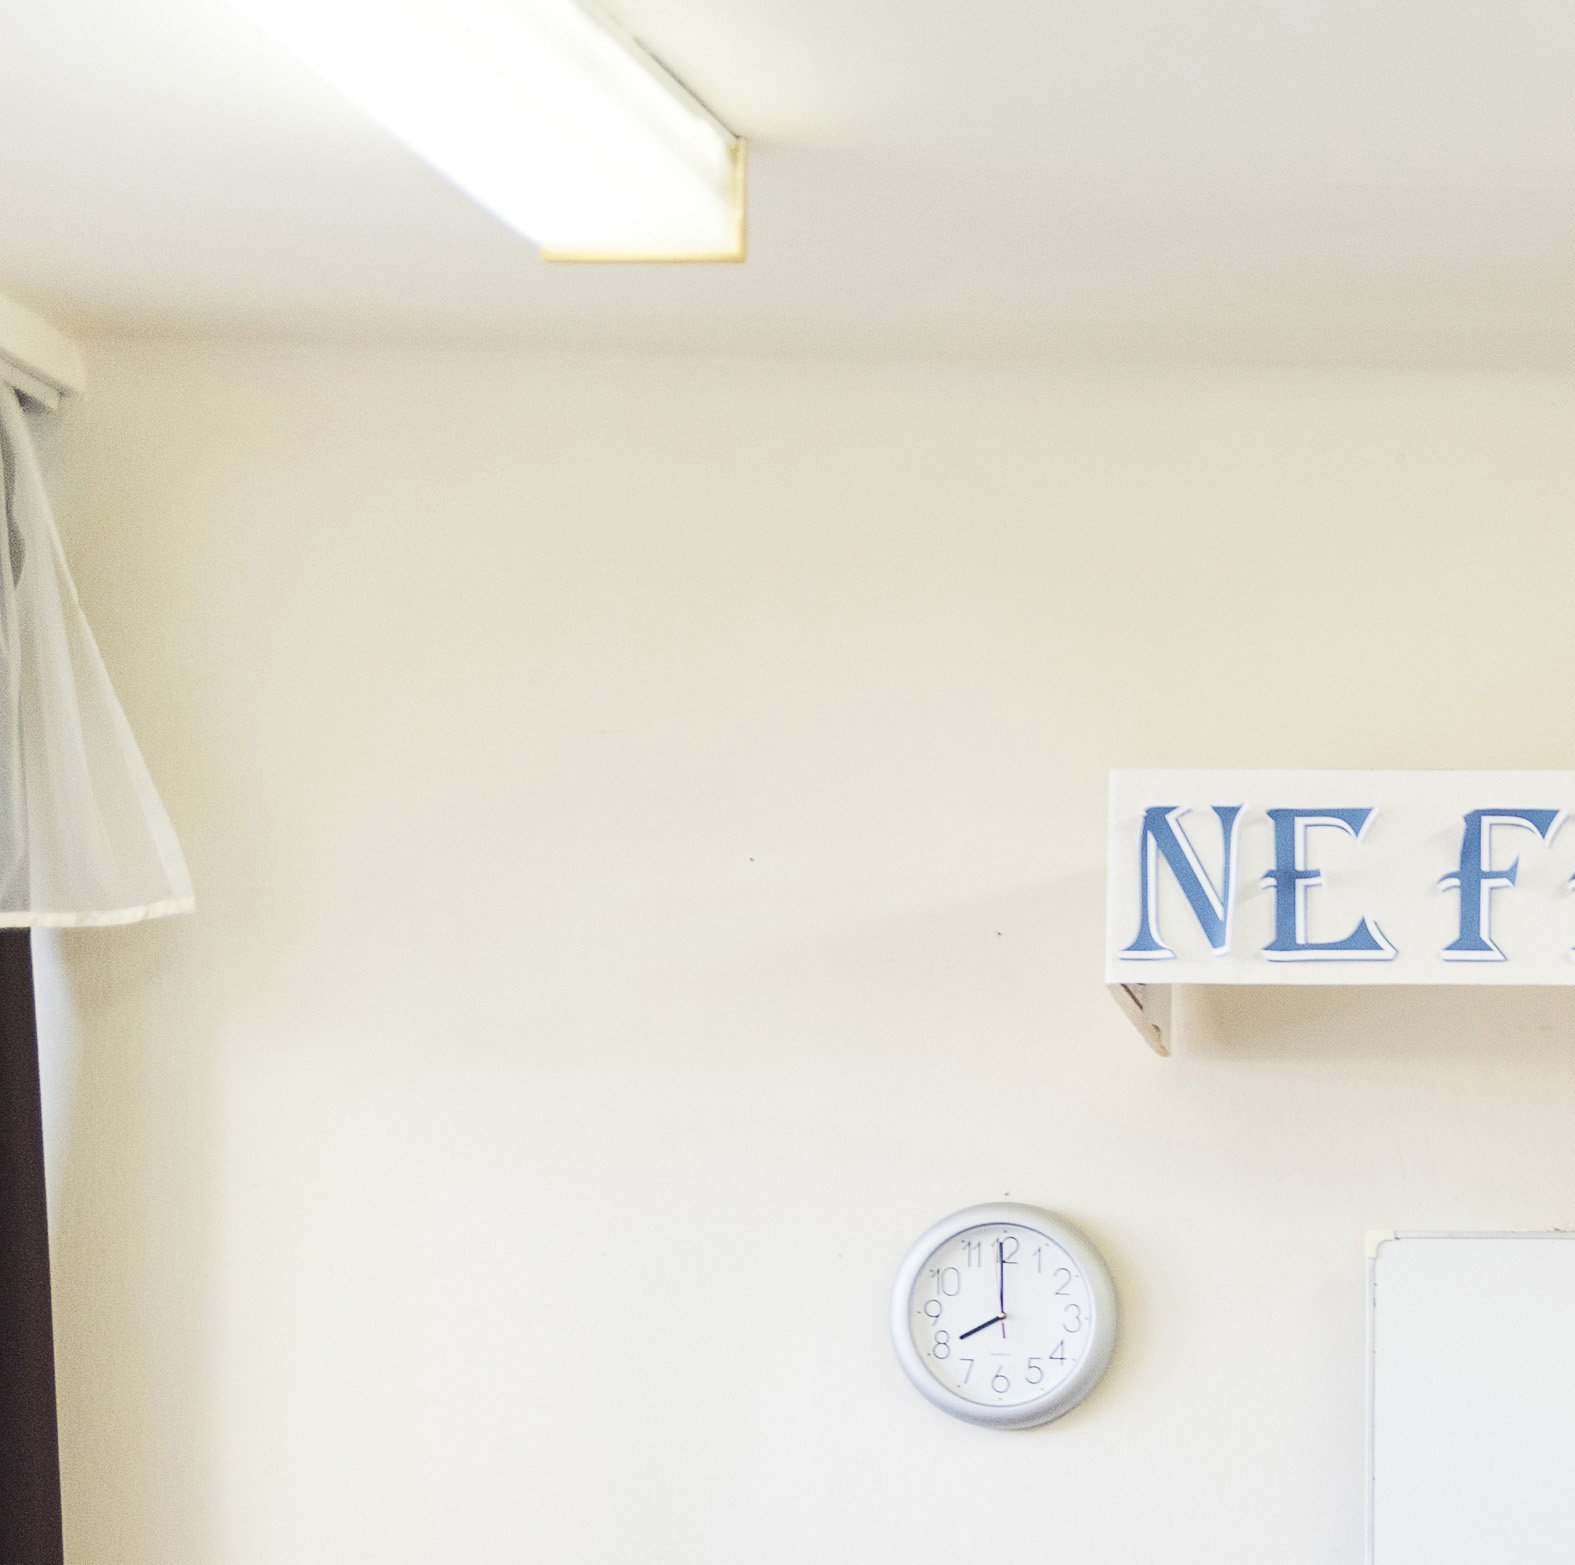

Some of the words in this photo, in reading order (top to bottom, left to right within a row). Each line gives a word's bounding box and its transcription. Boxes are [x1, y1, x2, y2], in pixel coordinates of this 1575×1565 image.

[1118, 803, 1399, 962] NE
[963, 1240, 982, 1268] 11
[992, 1236, 1020, 1265] 12
[1032, 1246, 1043, 1274] 1
[932, 1266, 961, 1297] 10
[1053, 1267, 1072, 1296] 2
[923, 1299, 943, 1327] 9
[1062, 1303, 1082, 1333] 3
[933, 1329, 951, 1360] 8
[1049, 1339, 1067, 1366] 4
[959, 1358, 975, 1385] 7
[991, 1365, 1011, 1394] 6
[1024, 1357, 1044, 1385] 5
